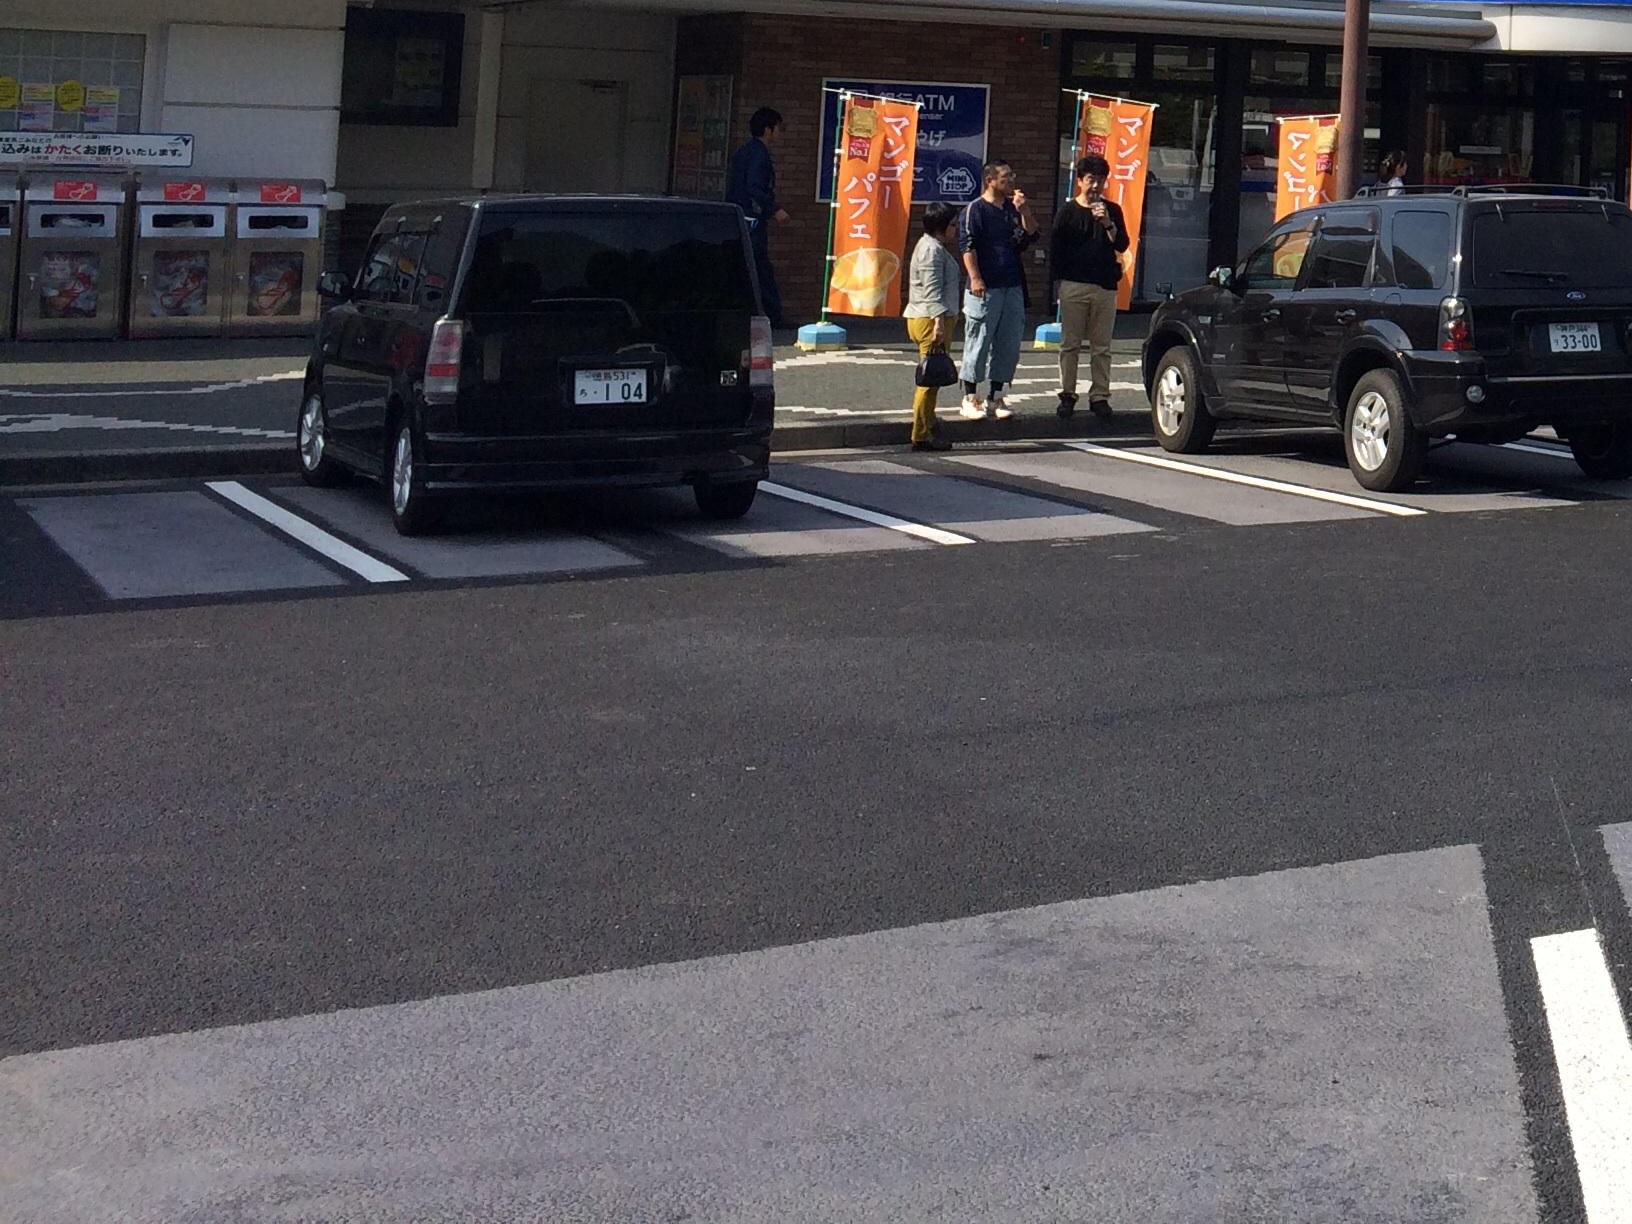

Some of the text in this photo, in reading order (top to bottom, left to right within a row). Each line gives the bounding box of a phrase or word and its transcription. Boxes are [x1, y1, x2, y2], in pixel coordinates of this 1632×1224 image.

[879, 115, 911, 209] マンゴー
[1112, 116, 1144, 206] マンゴー
[843, 171, 877, 240] パフェ
[1561, 334, 1598, 350] 33-00
